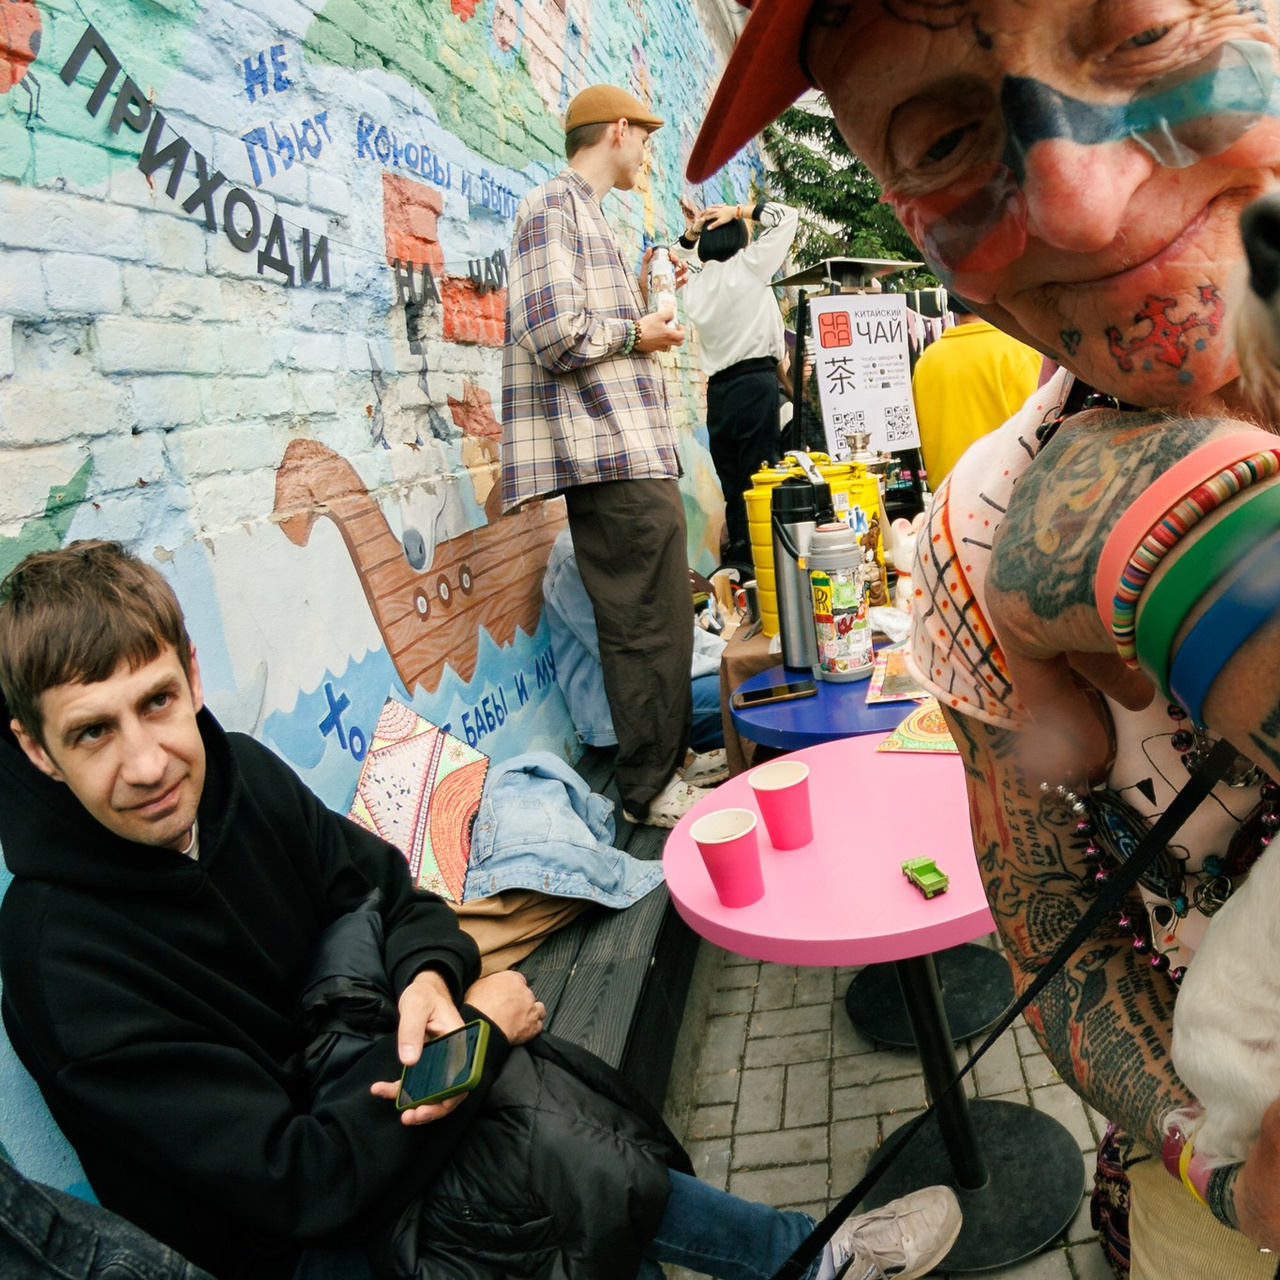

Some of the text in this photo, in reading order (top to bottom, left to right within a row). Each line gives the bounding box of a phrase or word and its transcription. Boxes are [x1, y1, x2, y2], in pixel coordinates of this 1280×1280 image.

[243, 43, 290, 105] НЕ
[60, 24, 332, 287] ПРИХОДИ
[394, 257, 442, 305] НА
[240, 110, 333, 188] ПЬЮТ
[356, 115, 451, 190] КОРОВЫ
[854, 308, 902, 319] КИТАЙСКИЙ
[856, 318, 903, 345] ЧАЙ
[824, 355, 857, 396] 茶
[461, 685, 509, 749] БАБЫ
[513, 671, 530, 707] И
[535, 644, 557, 691] МУ
